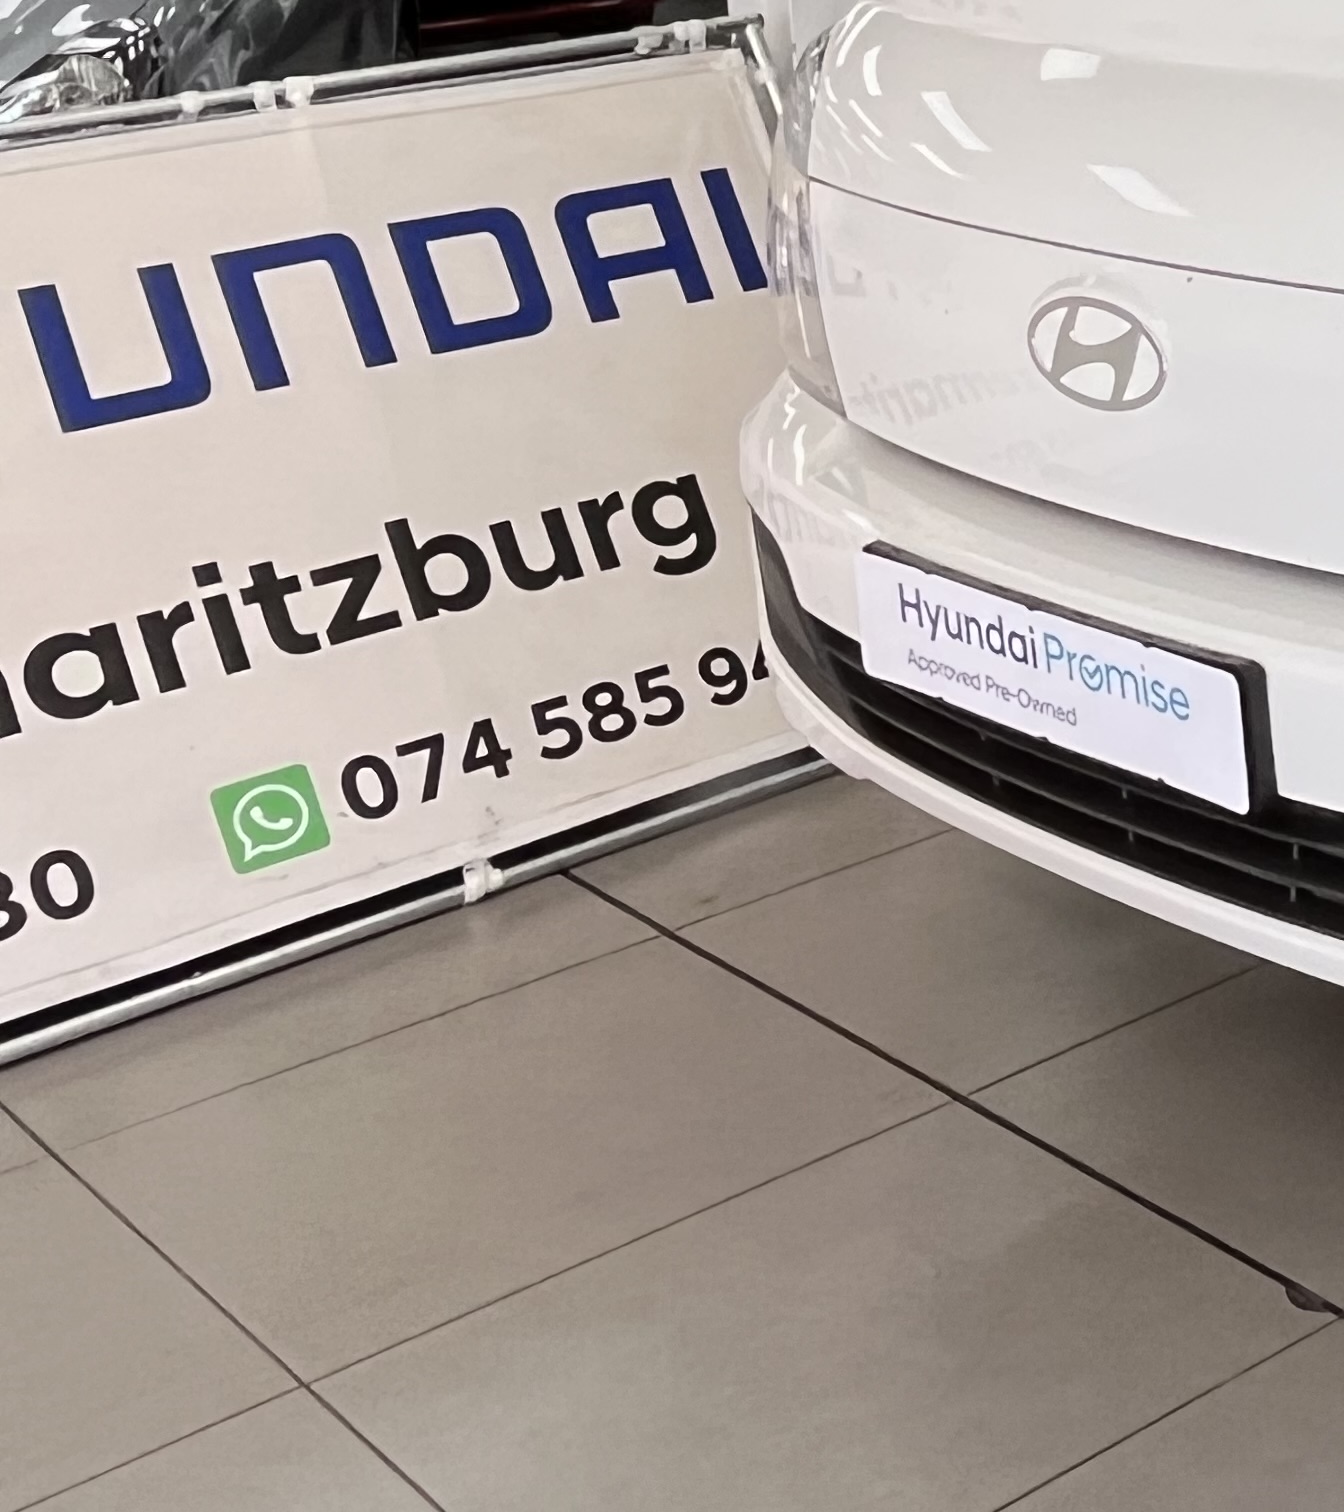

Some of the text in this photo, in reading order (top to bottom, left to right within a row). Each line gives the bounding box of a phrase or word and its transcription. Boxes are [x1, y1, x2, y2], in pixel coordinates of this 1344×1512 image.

[16, 167, 768, 433] UNDAI
[897, 582, 1191, 722] Hyundai Promise
[340, 717, 513, 820] 074
[530, 663, 685, 760] 585
